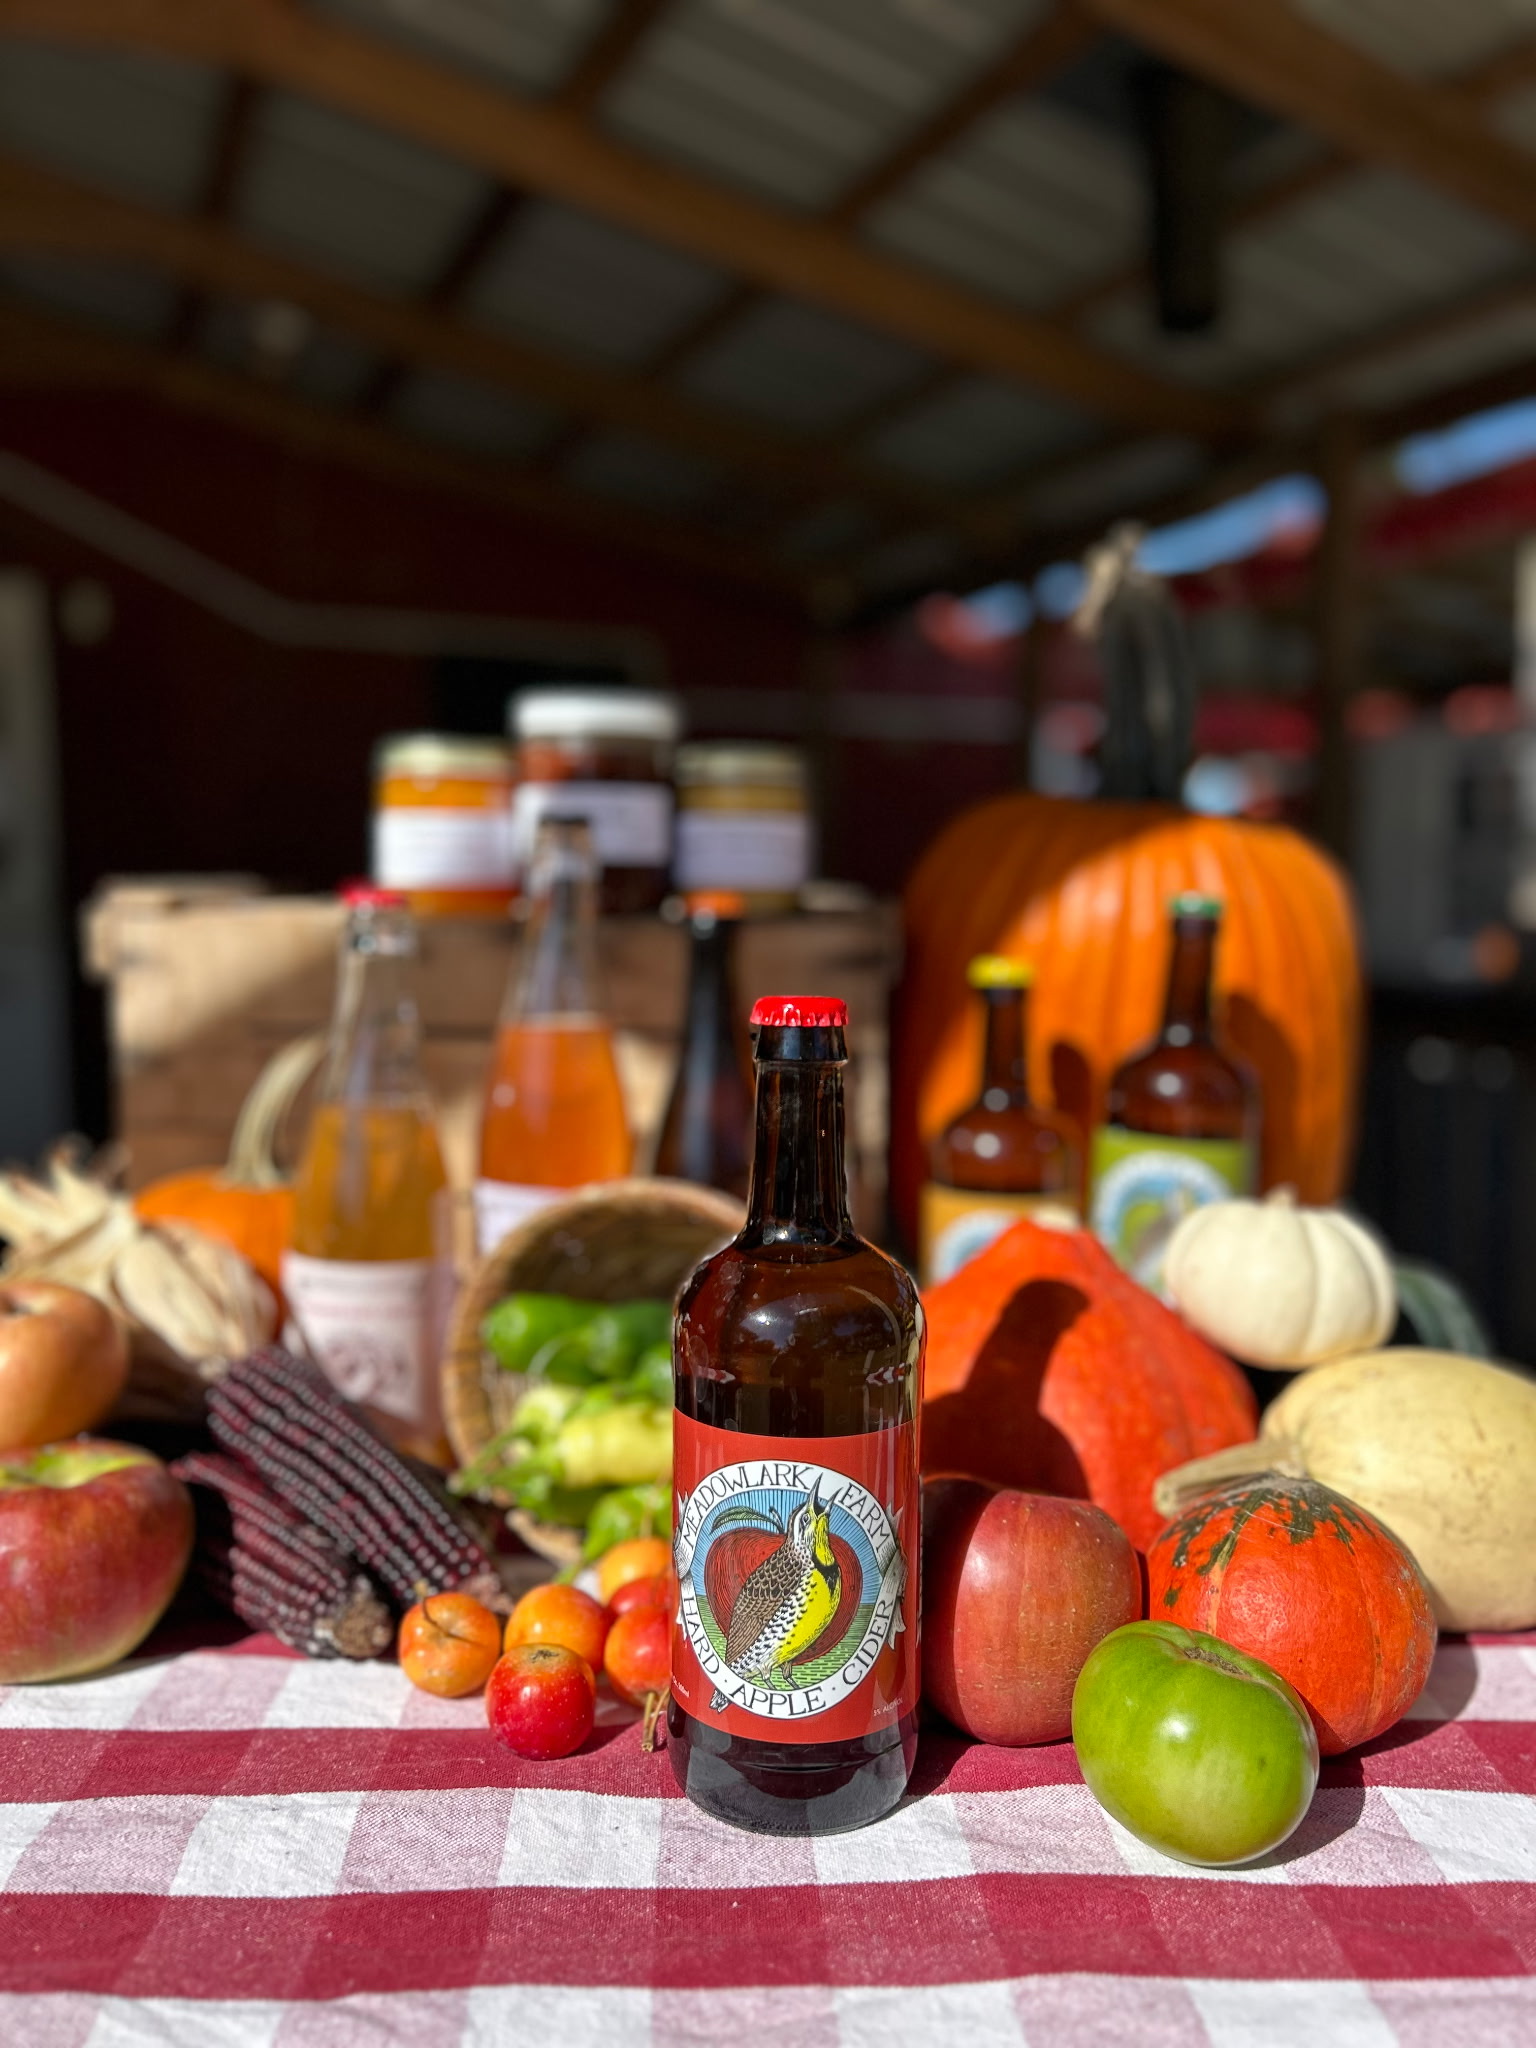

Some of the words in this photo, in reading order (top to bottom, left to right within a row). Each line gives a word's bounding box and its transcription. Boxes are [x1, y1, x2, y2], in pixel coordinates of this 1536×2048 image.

[683, 1462, 814, 1551] MEADOWLARK
[838, 1482, 891, 1553] FARM
[683, 1597, 720, 1675] HARD
[728, 1683, 827, 1717] APPLE
[842, 1599, 894, 1686] CIDER
